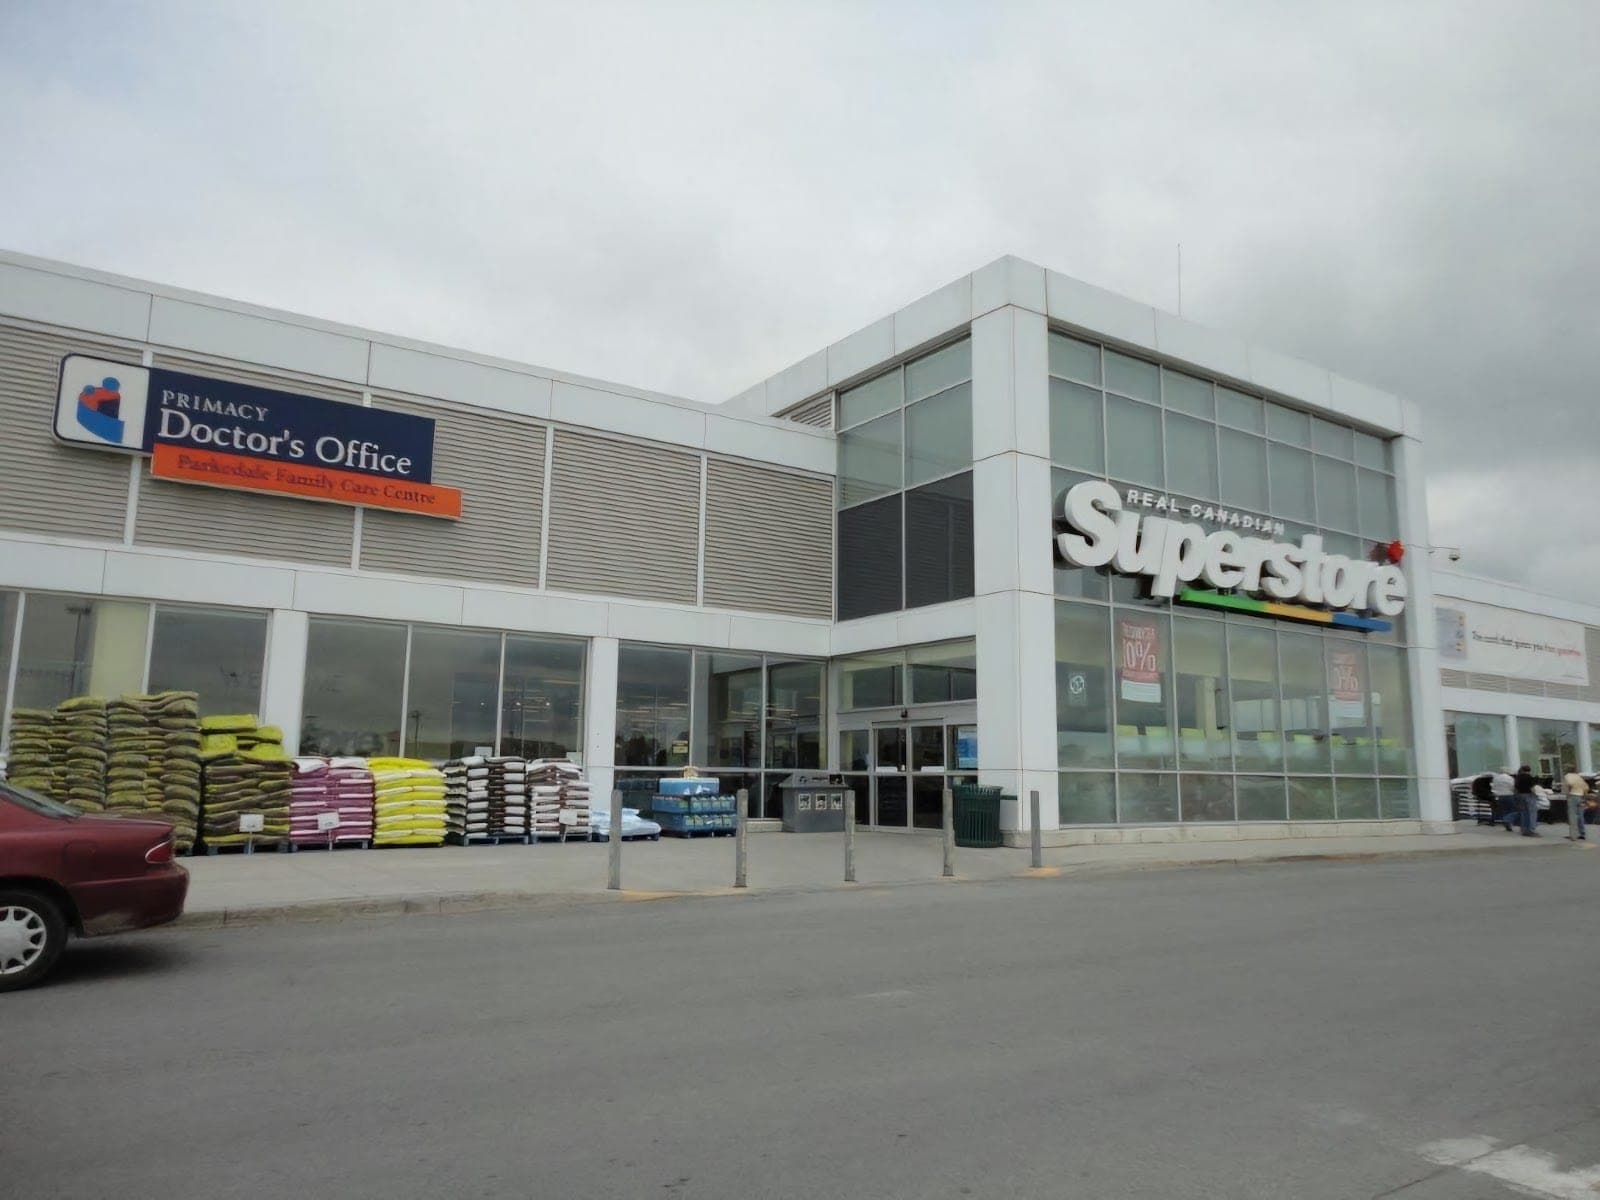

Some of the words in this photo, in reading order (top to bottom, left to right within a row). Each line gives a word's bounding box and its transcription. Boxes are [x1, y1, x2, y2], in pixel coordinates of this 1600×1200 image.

[162, 389, 269, 421] PRIMACY
[157, 408, 305, 458] Doctor's
[315, 436, 412, 474] Office
[276, 467, 334, 493] Family
[341, 479, 379, 496] Care
[384, 484, 436, 505] Centre
[1126, 488, 1180, 513] REAL
[1190, 503, 1286, 536] CANADIAN
[1057, 480, 1409, 617] Superstore
